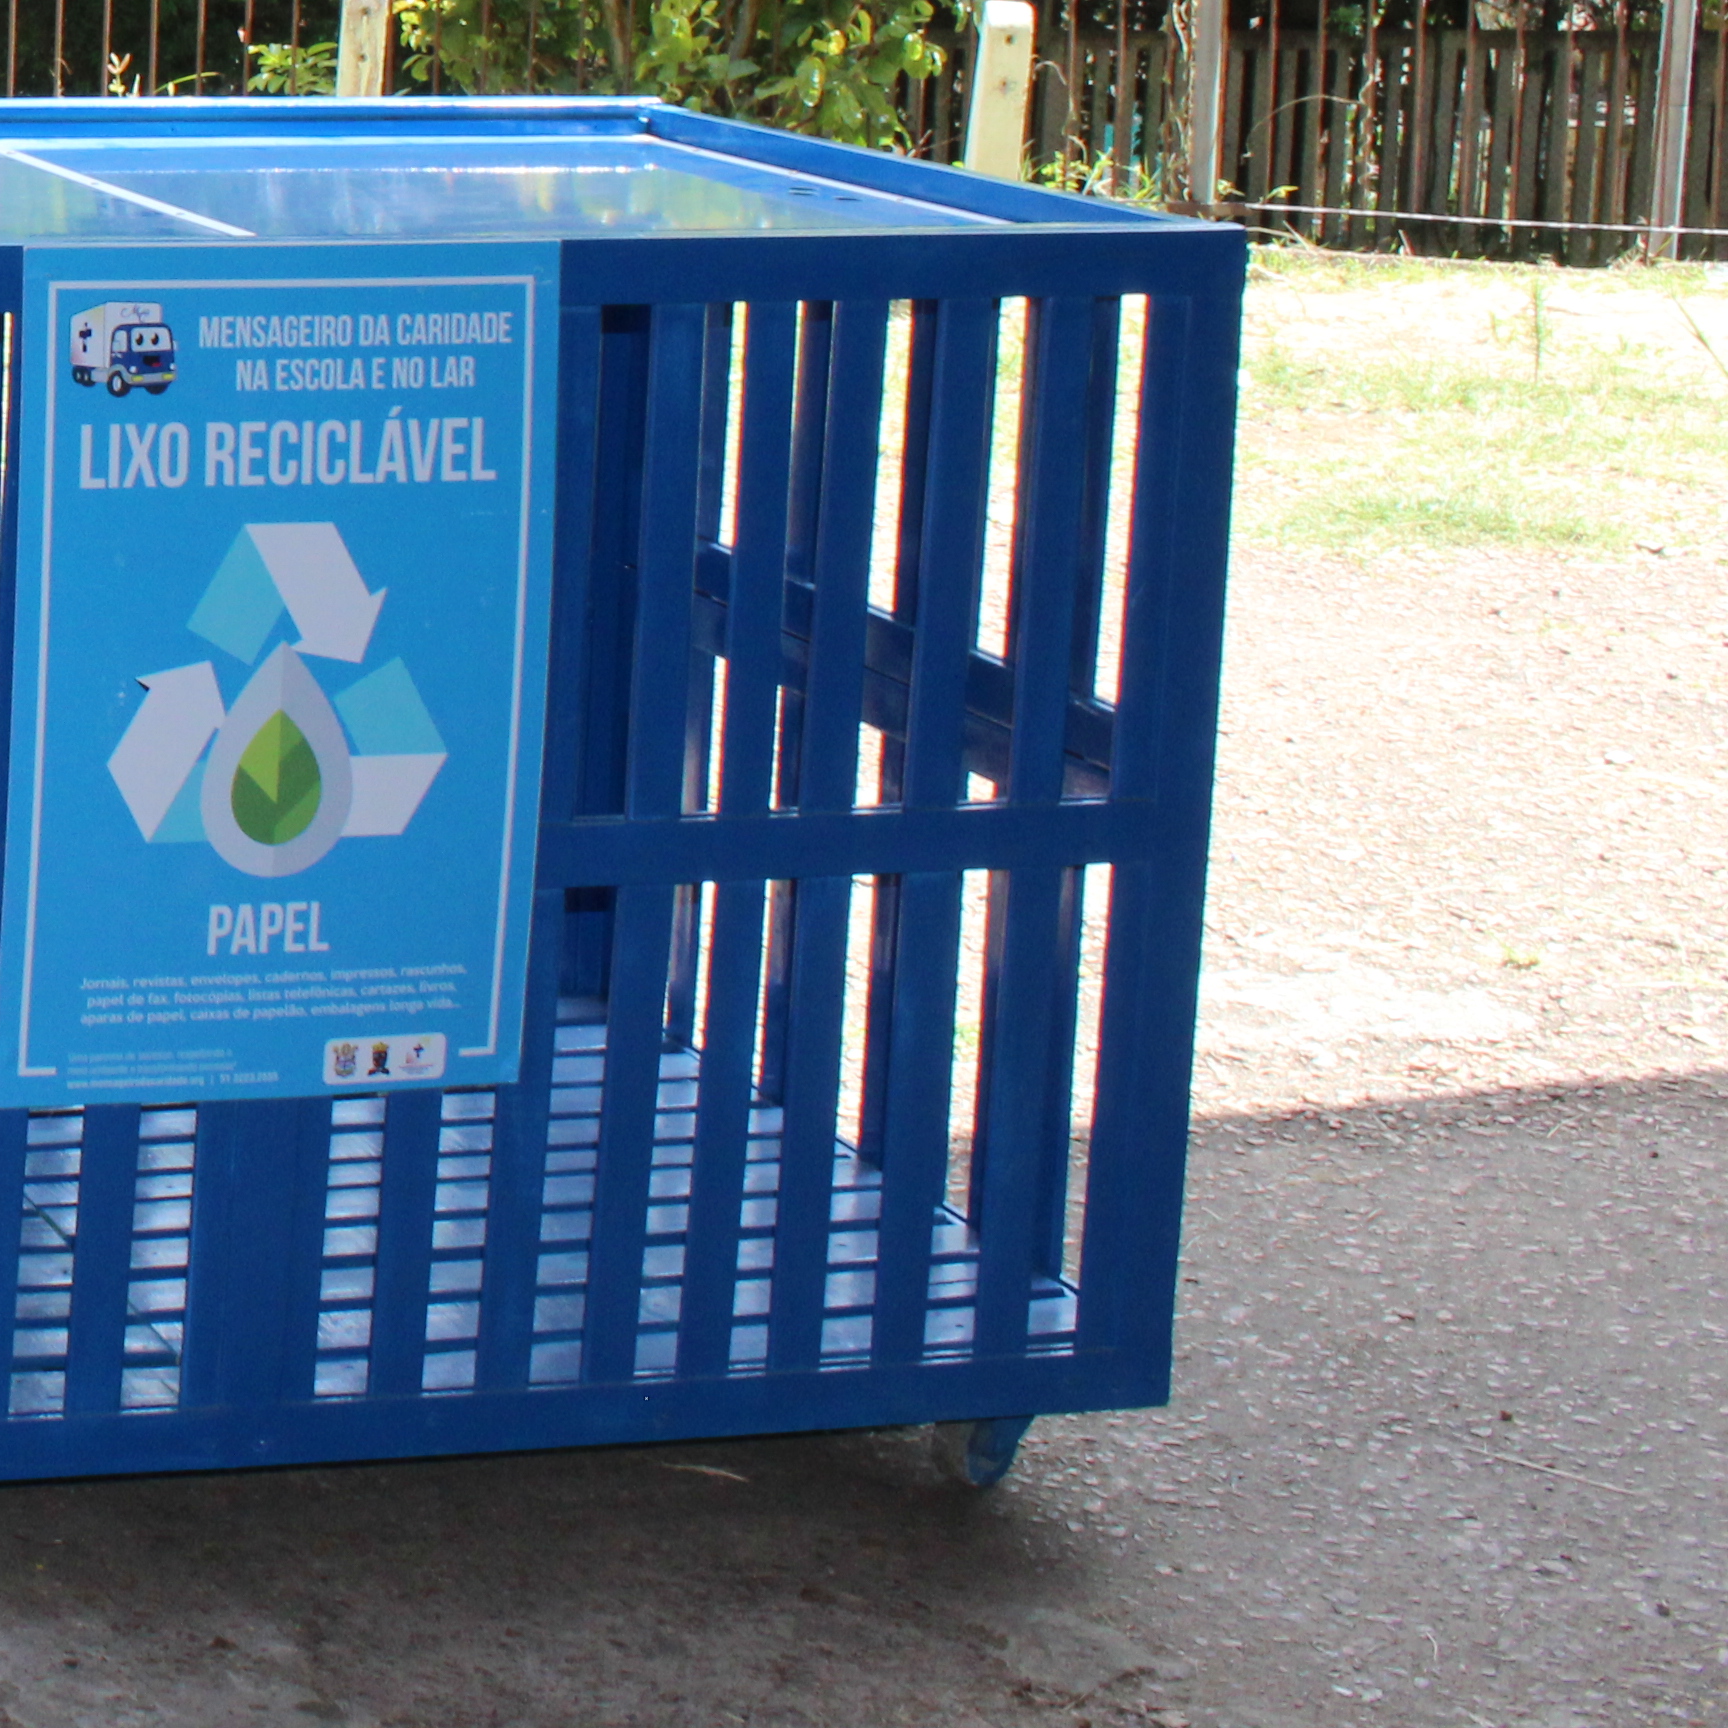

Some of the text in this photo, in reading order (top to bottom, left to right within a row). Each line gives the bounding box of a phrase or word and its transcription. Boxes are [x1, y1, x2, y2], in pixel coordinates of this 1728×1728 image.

[198, 311, 514, 349] MENSAGEIRO DA CARIDADE
[235, 354, 477, 391] NA ESCOLA E NO LAR
[79, 405, 497, 490] LIXO RECICLÁVEL
[206, 900, 330, 956] PAPEL
